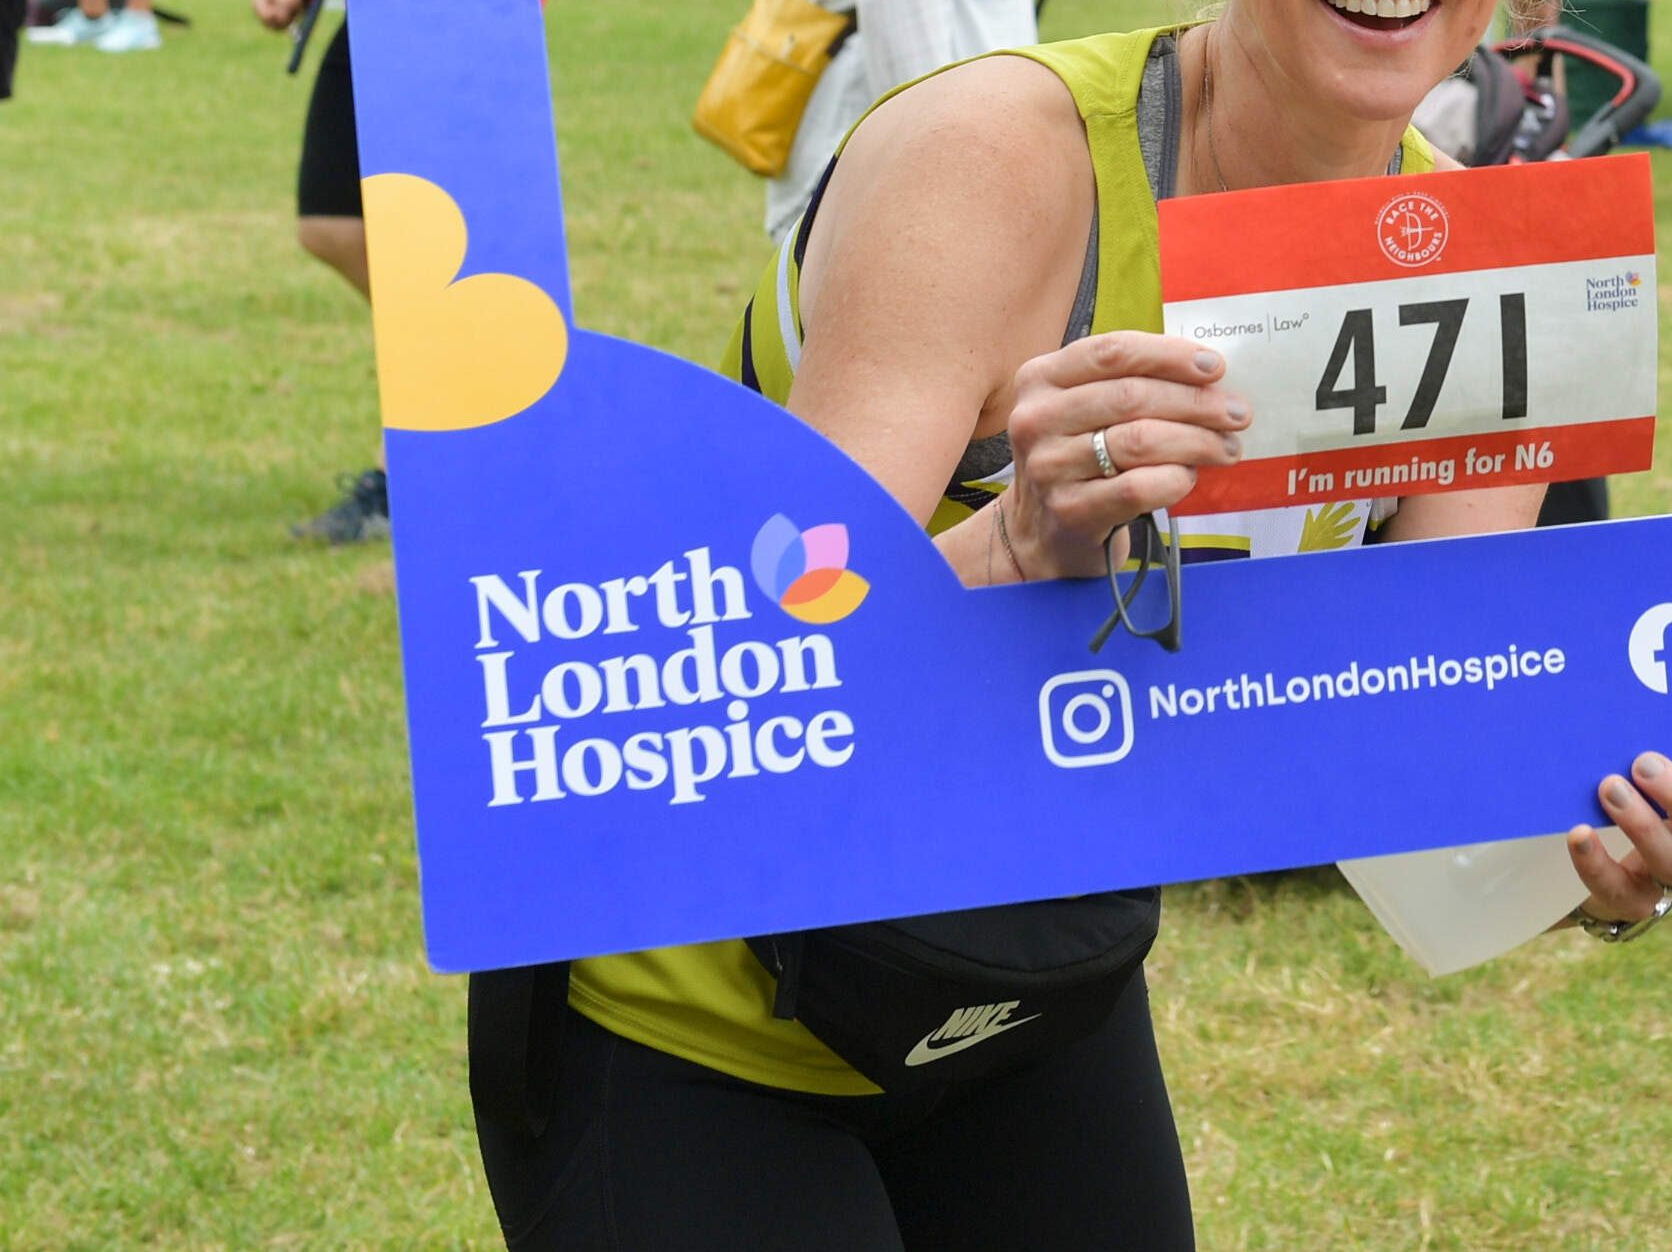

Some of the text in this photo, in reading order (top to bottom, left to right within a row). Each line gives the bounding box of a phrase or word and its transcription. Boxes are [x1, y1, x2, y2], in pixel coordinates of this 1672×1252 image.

[1384, 232, 1443, 262] NEIGHBOURS
[1586, 275, 1624, 288] North
[1587, 287, 1636, 300] London
[1588, 297, 1638, 311] Hospice
[1194, 322, 1264, 339] Osbornes
[1315, 292, 1528, 436] 471
[1344, 456, 1455, 485] running
[1465, 447, 1506, 476] for
[1514, 441, 1555, 471] N6
[469, 546, 753, 649] North
[476, 624, 842, 727] London
[1149, 644, 1566, 719] NorthLondonHospice
[482, 699, 855, 807] Hospice
[931, 1000, 1021, 1042] NIKE
